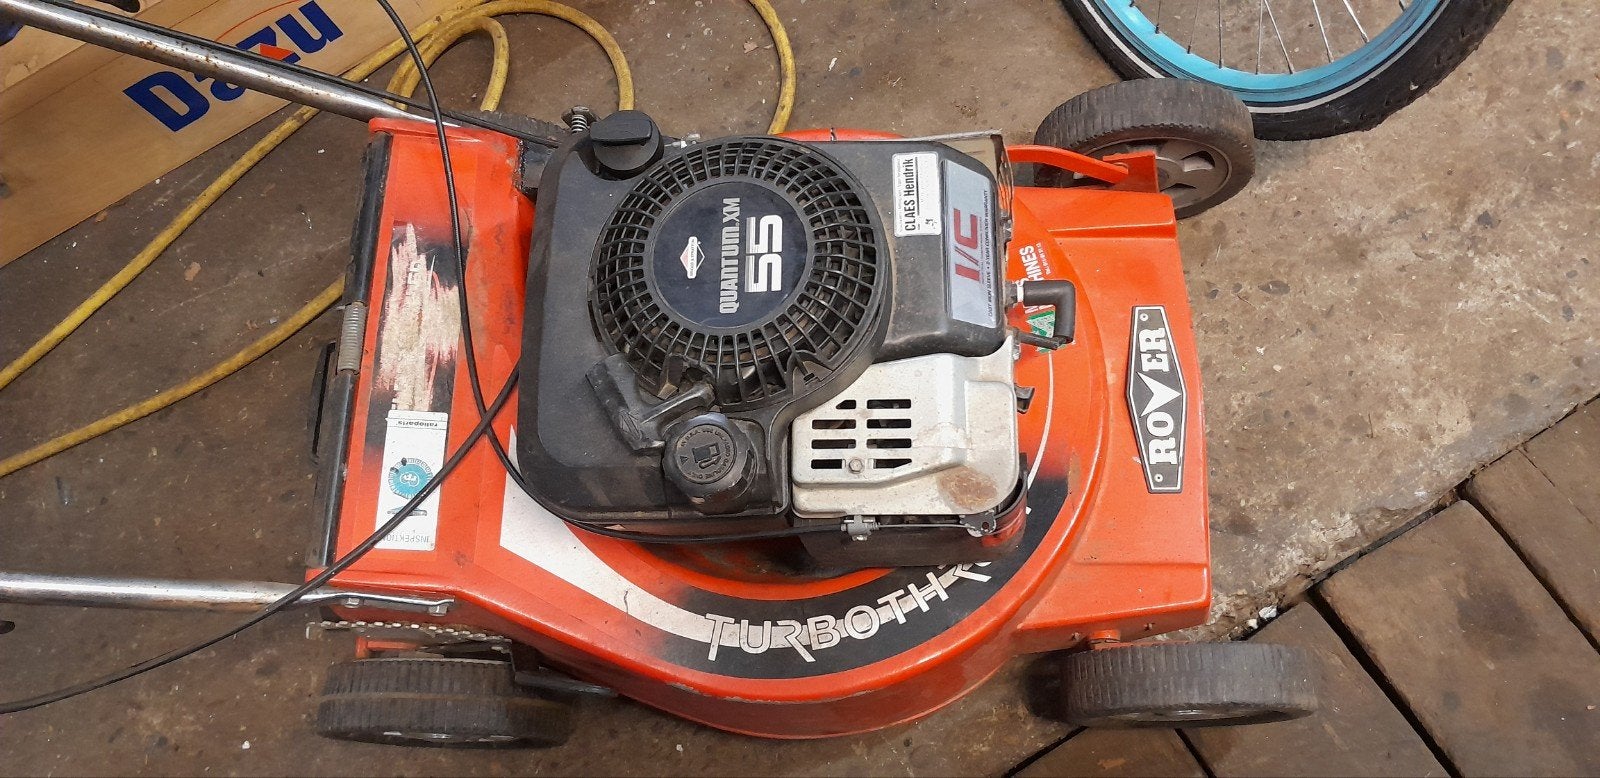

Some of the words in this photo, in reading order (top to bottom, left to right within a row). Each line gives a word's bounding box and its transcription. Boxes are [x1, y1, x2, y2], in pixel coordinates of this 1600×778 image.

[902, 158, 915, 197] Hendrik
[904, 200, 916, 231] CLAES
[953, 208, 980, 282] I/C
[745, 214, 783, 293] 55
[1136, 327, 1182, 465] ROVER
